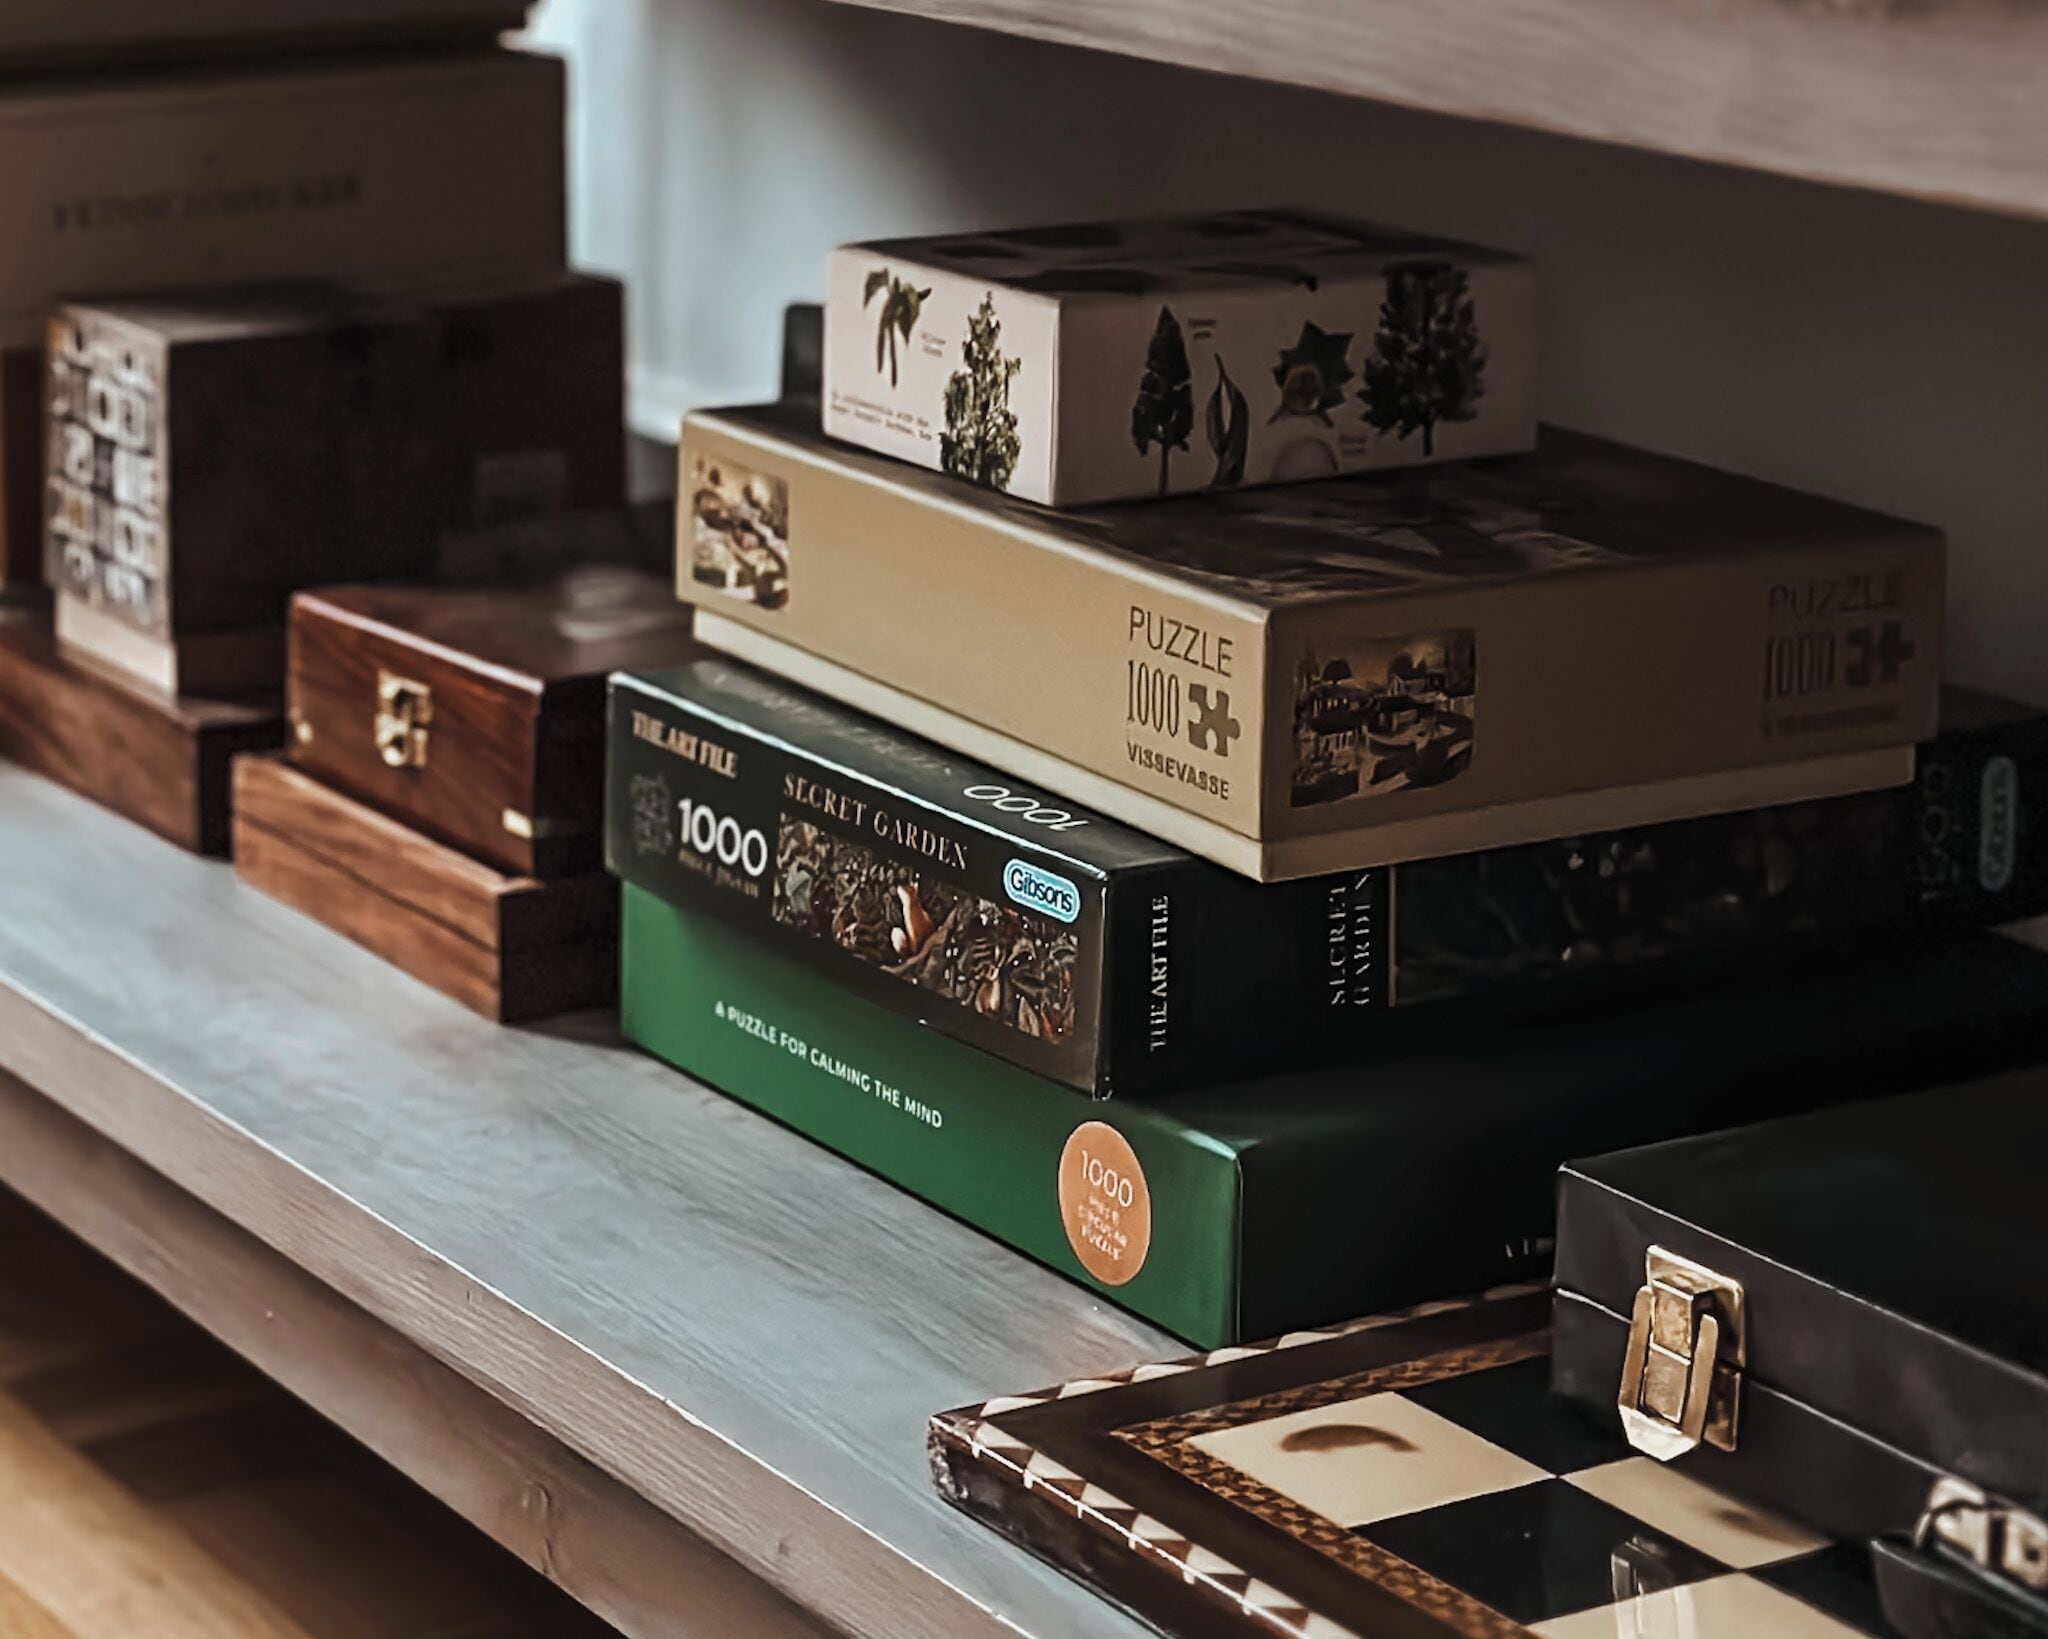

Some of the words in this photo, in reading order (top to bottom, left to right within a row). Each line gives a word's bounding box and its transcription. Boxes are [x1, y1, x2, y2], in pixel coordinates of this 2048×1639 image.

[1129, 605, 1234, 678] PUZZLE
[1127, 659, 1181, 738] 1000
[631, 708, 668, 748] THE
[699, 740, 739, 779] FILE
[1126, 739, 1231, 800] VISSEVASSE
[676, 796, 769, 877] 1000
[782, 770, 868, 826] SECRET
[872, 809, 969, 871] GARDEN
[962, 784, 1090, 832] 1000
[1010, 865, 1075, 914] Gibsons
[1151, 894, 1170, 949] FILE
[1150, 952, 1169, 999] ART
[1327, 885, 1348, 1007] SECRET
[1149, 1000, 1169, 1053] THE
[714, 1000, 726, 1018] A
[726, 1005, 778, 1045] PUZZLE
[780, 1031, 808, 1060] FOR
[810, 1047, 872, 1093] CALMING
[873, 1079, 902, 1109] THE
[904, 1096, 944, 1129] MIND
[1081, 1149, 1133, 1208] 1000
